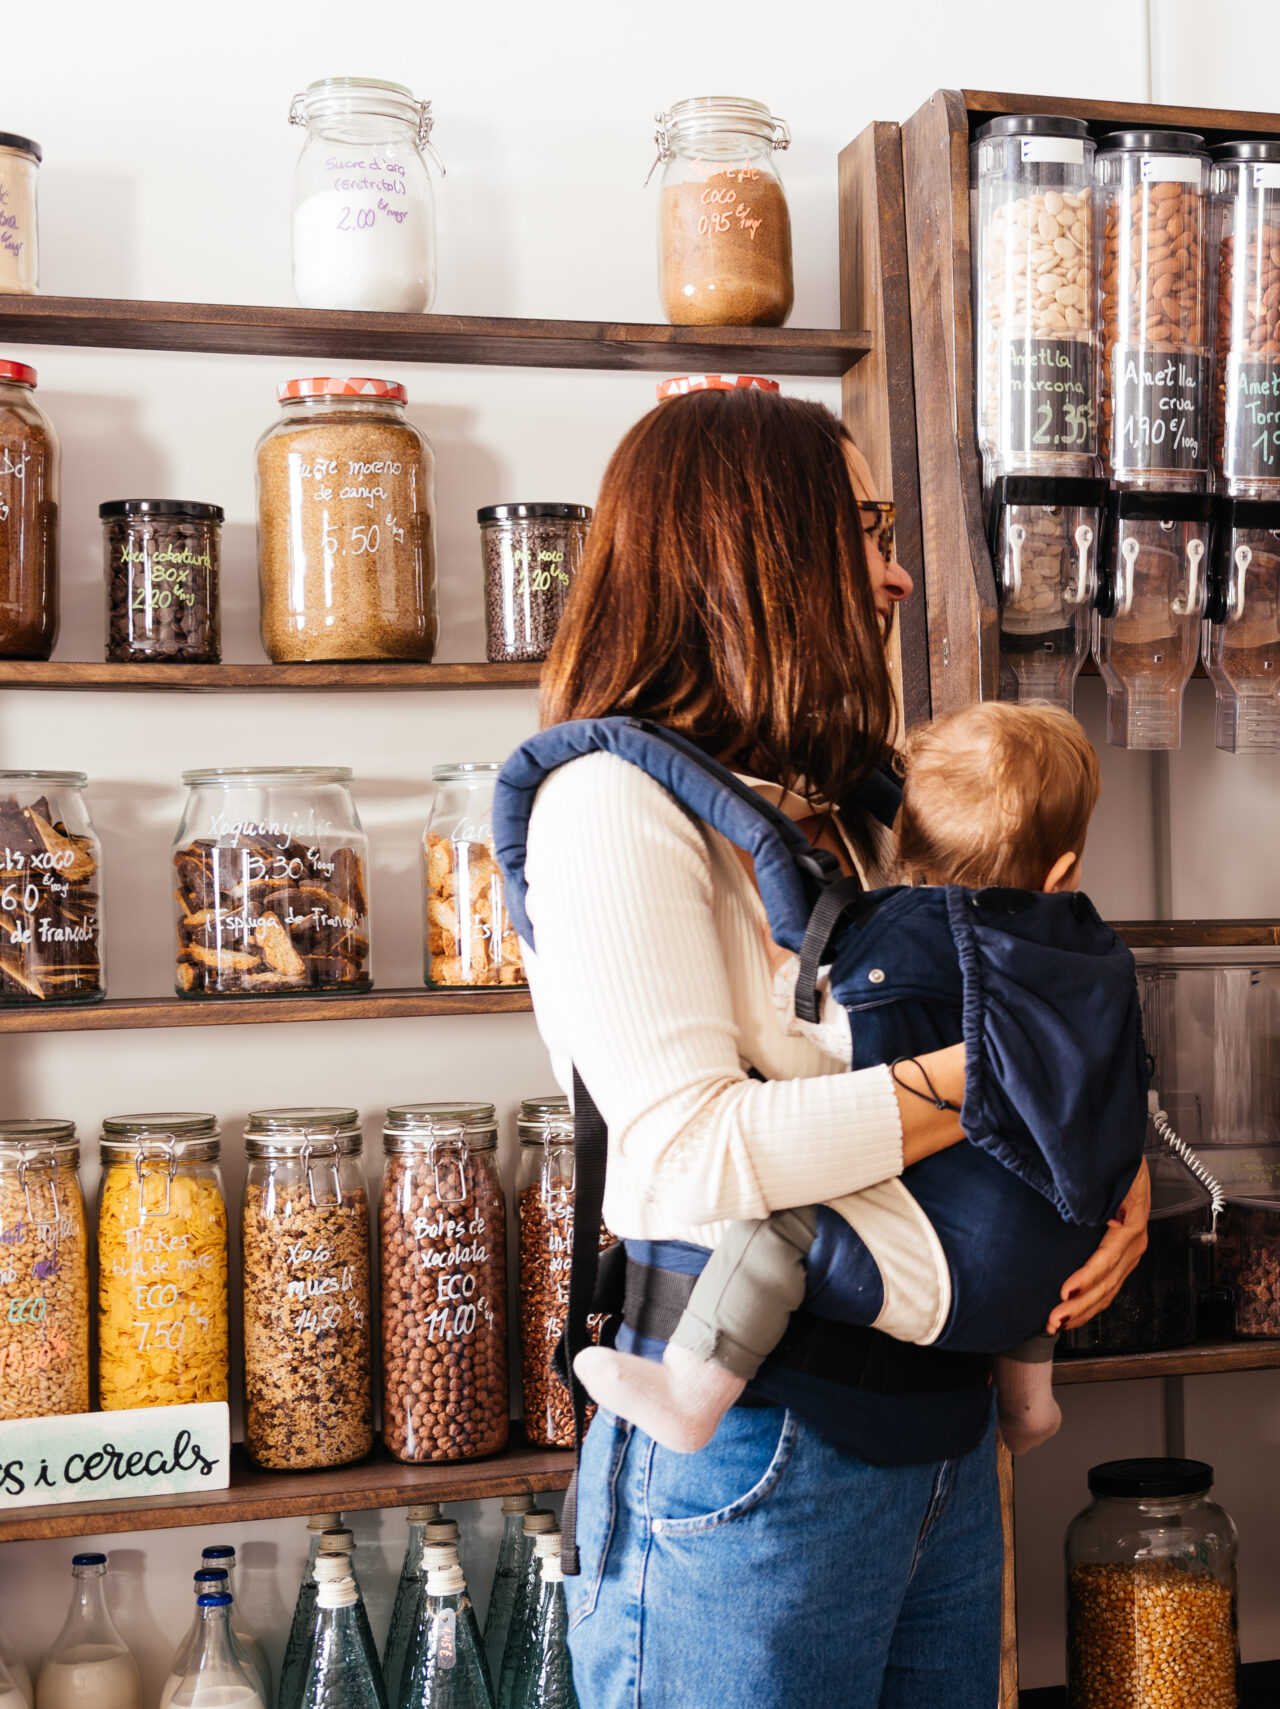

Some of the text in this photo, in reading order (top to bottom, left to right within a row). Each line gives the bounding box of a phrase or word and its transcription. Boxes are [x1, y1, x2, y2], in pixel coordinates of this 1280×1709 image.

[700, 187, 737, 206] coco
[1159, 396, 1195, 412] crua
[348, 460, 402, 481] moreno
[313, 483, 389, 510] de canya
[10, 919, 33, 944] de
[135, 1283, 178, 1310] ECO
[436, 1273, 477, 1302] ECO
[7, 1297, 47, 1323] ECO
[34, 1458, 57, 1487] i
[63, 1429, 220, 1484] cereals
